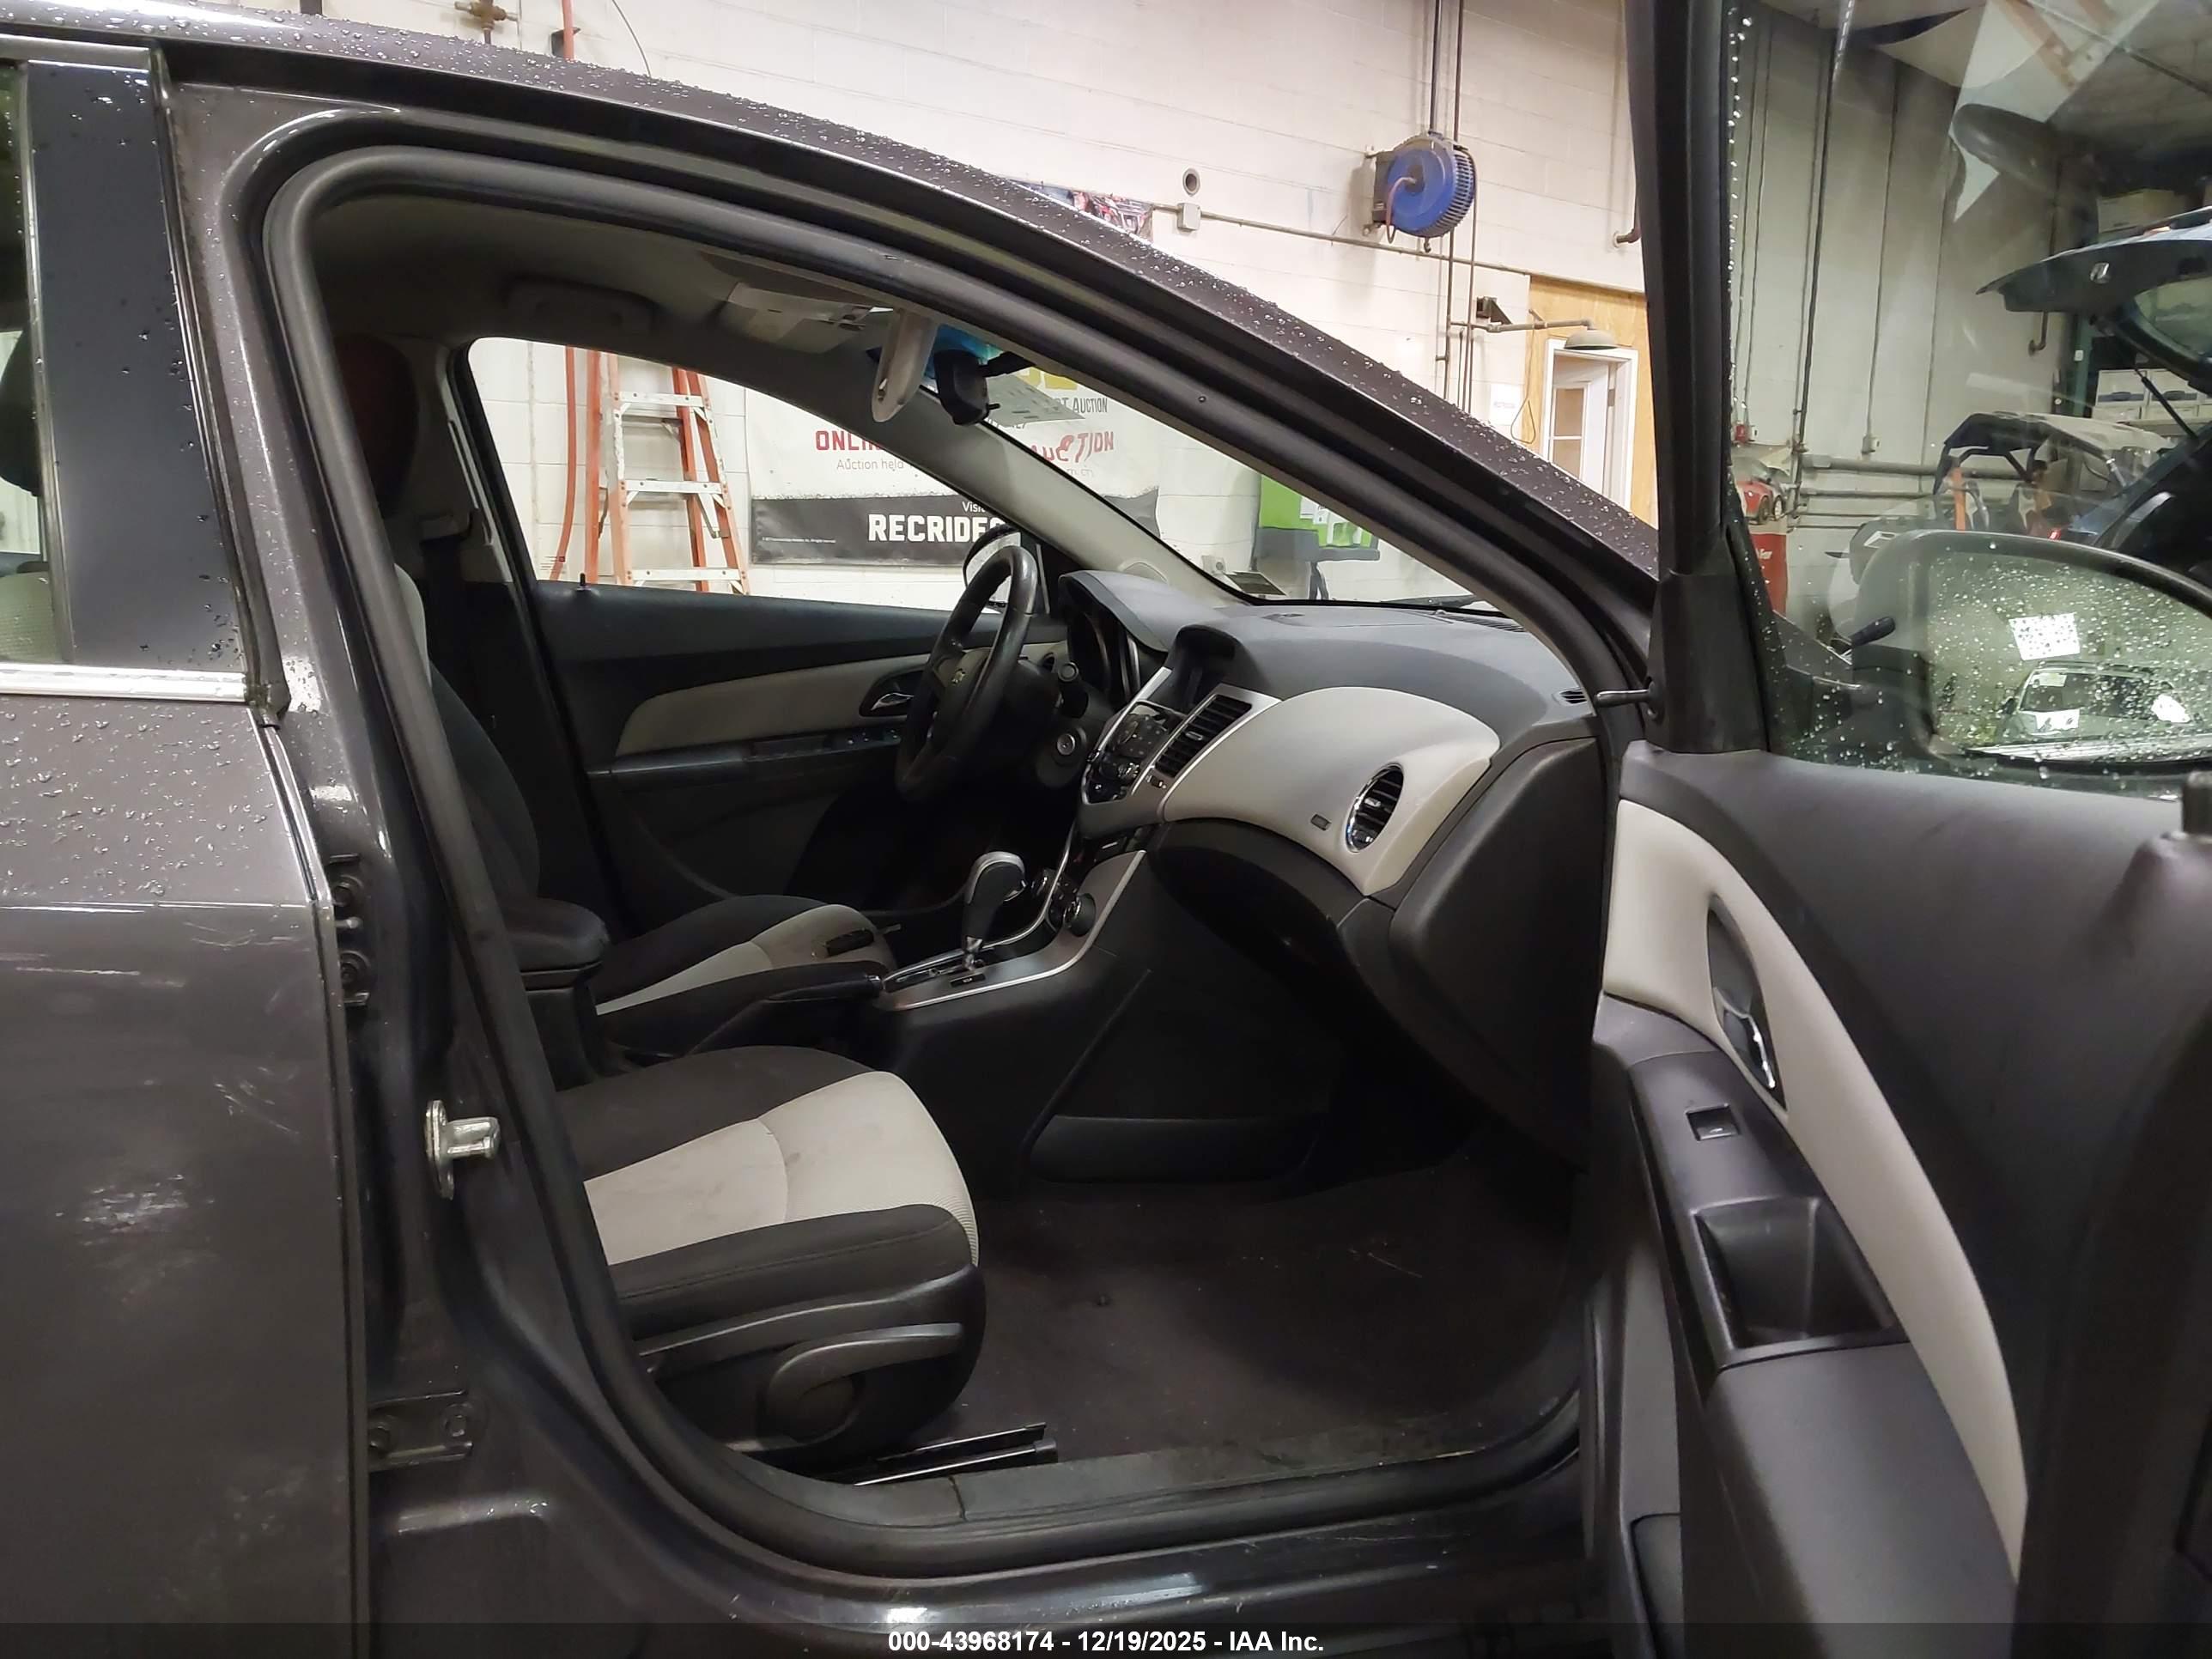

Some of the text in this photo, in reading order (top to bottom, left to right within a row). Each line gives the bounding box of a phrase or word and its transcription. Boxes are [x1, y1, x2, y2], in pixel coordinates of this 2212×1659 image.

[1073, 398, 1108, 413] AUCTION
[816, 430, 881, 451] ONLI
[836, 459, 878, 470] Auction
